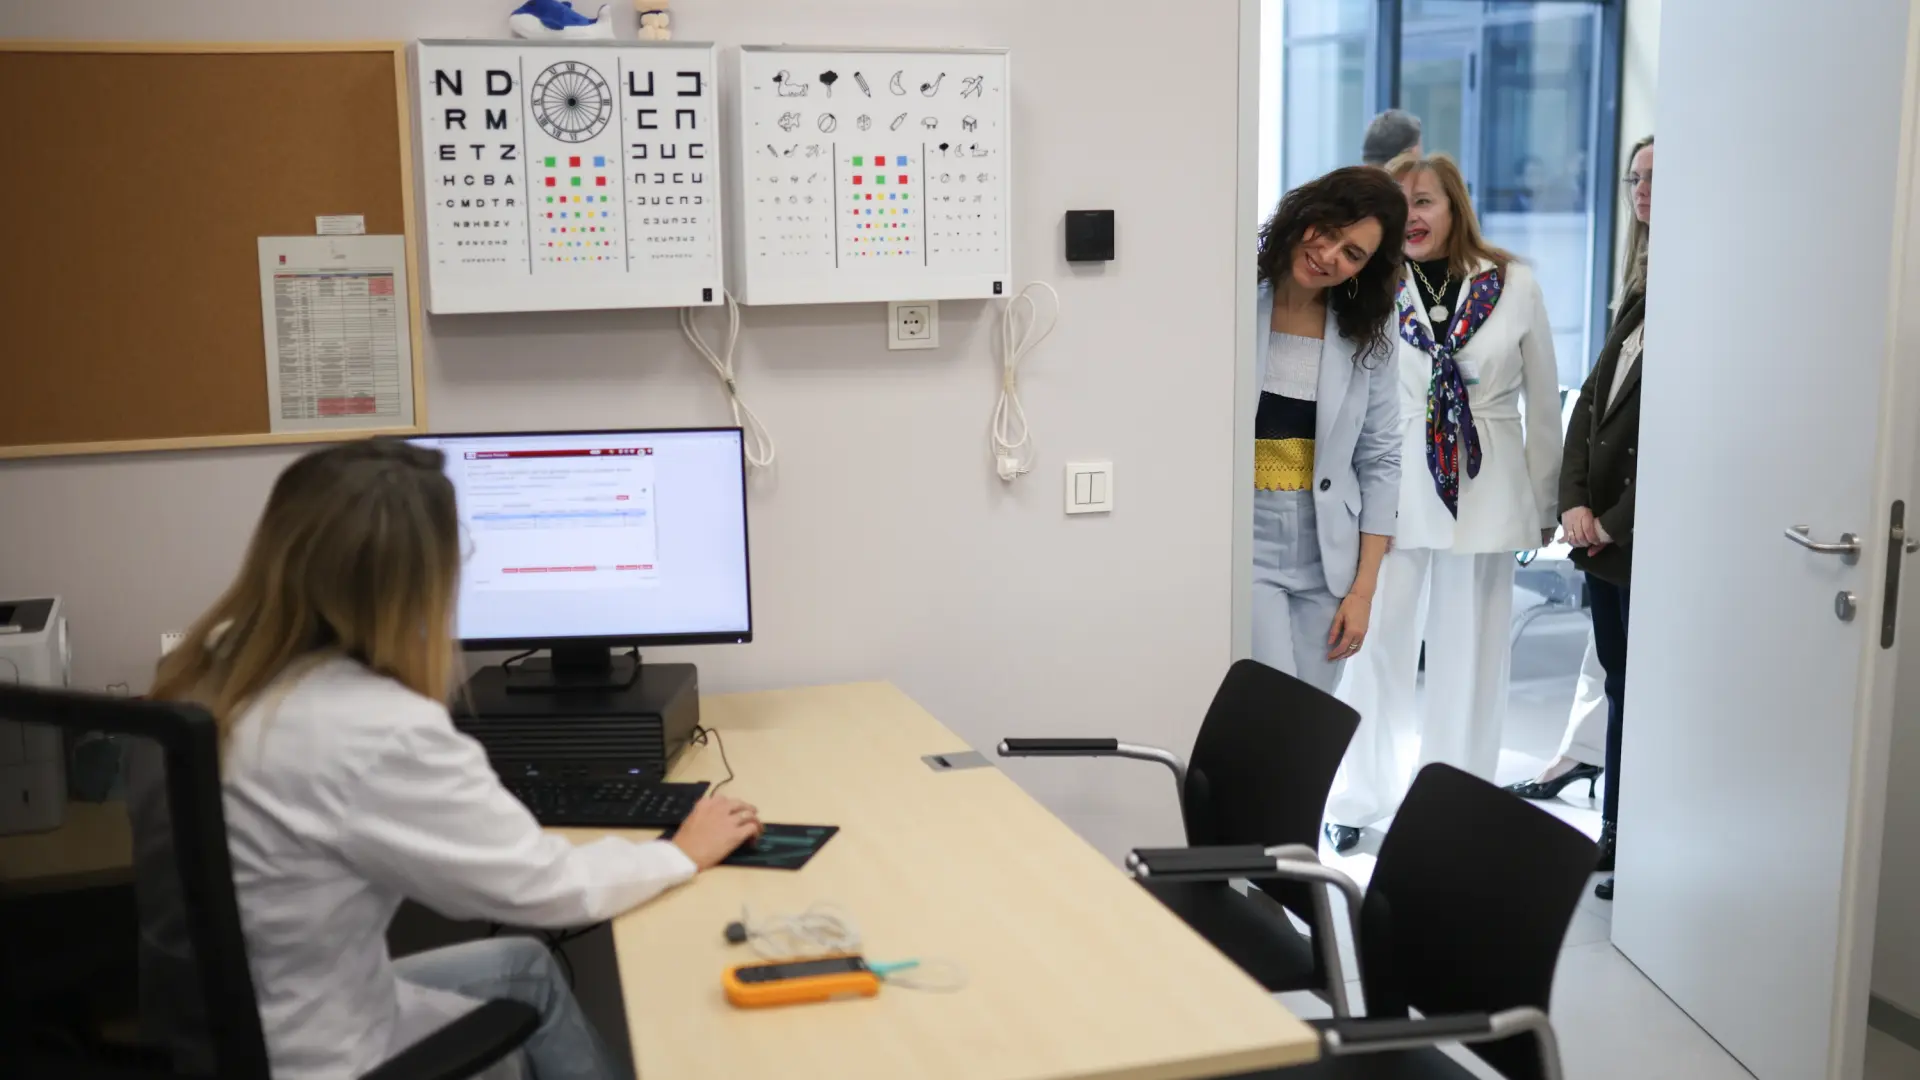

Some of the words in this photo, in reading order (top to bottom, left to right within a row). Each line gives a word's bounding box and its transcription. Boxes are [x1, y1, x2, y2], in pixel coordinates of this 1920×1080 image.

[566, 63, 576, 71] XII
[435, 69, 463, 96] N
[486, 69, 513, 96] D
[444, 108, 467, 130] R
[485, 108, 507, 130] M
[569, 133, 578, 141] VI
[439, 144, 456, 161] E
[469, 144, 485, 161] T
[499, 144, 516, 161] Z
[443, 175, 455, 186] H
[464, 175, 475, 186] C
[484, 175, 495, 186] B
[504, 175, 515, 186] A
[446, 199, 455, 208] C
[461, 199, 470, 208] M
[492, 198, 500, 207] T
